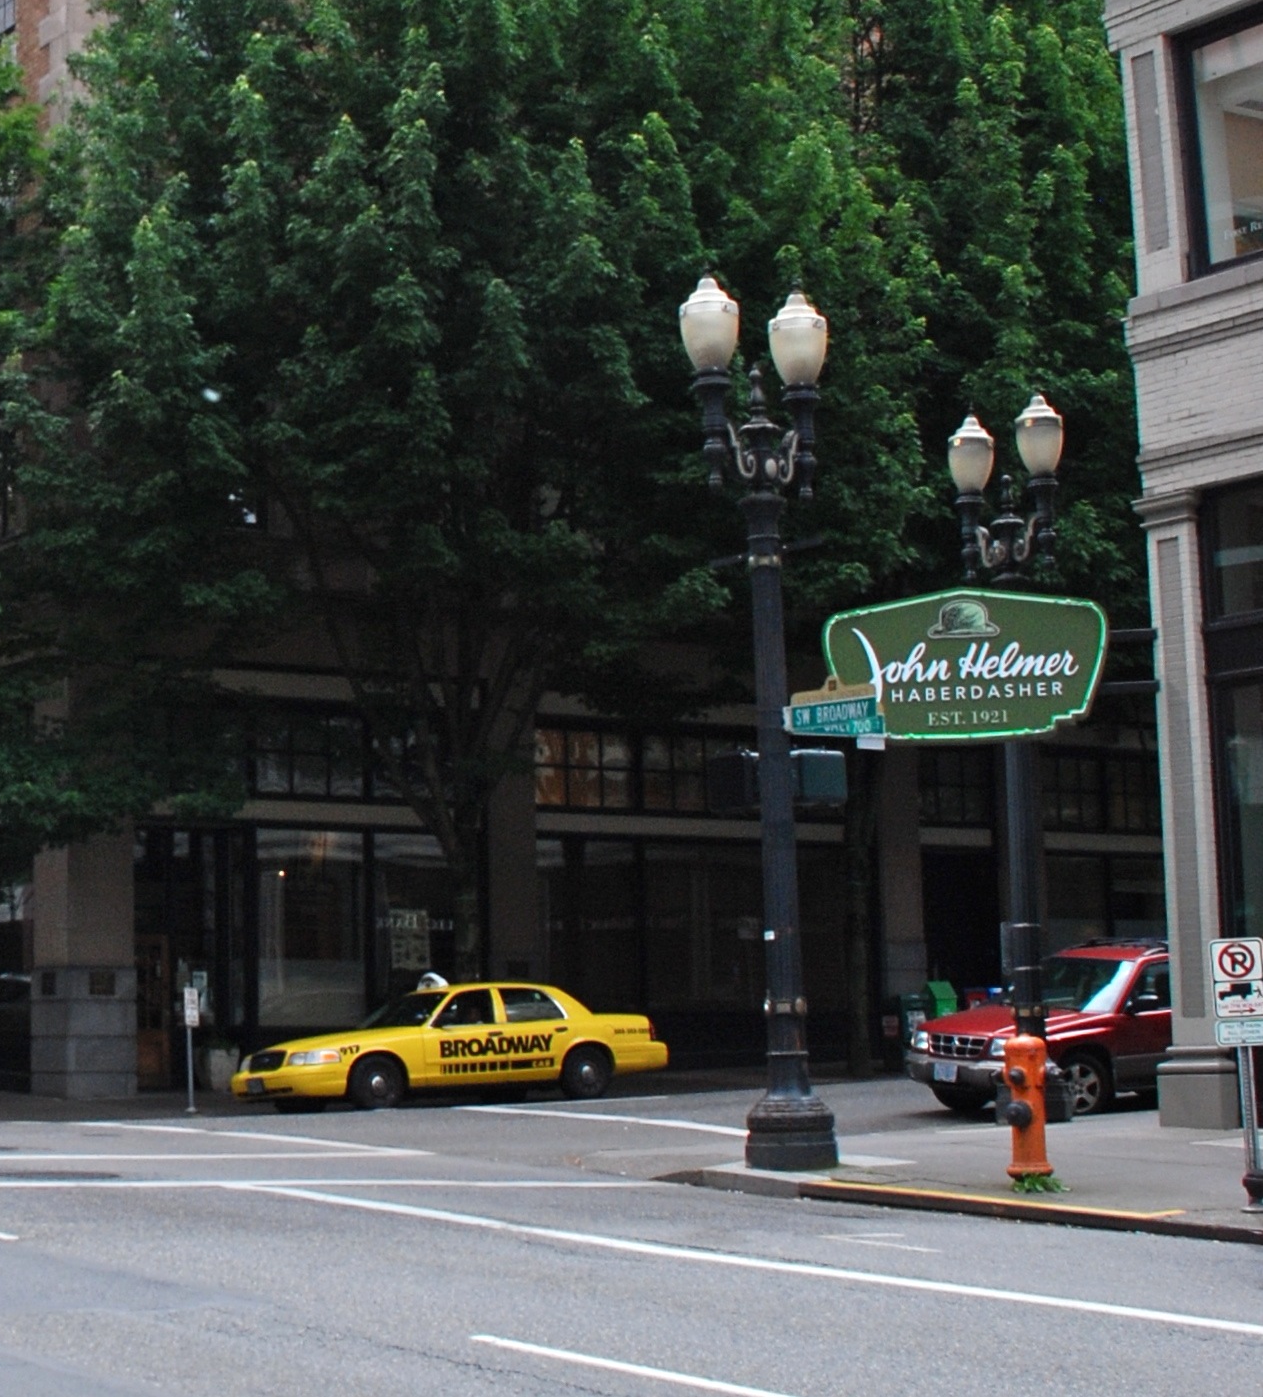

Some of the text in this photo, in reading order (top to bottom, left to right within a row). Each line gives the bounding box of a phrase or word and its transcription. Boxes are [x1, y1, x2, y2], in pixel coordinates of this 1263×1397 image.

[851, 627, 1079, 702] John Helmer
[891, 681, 1064, 702] HABERDASHER
[795, 701, 869, 726] SW BROADWAY
[927, 709, 1009, 726] EST. 1921
[340, 1044, 360, 1055] 917
[440, 1034, 553, 1058] BROADWAY
